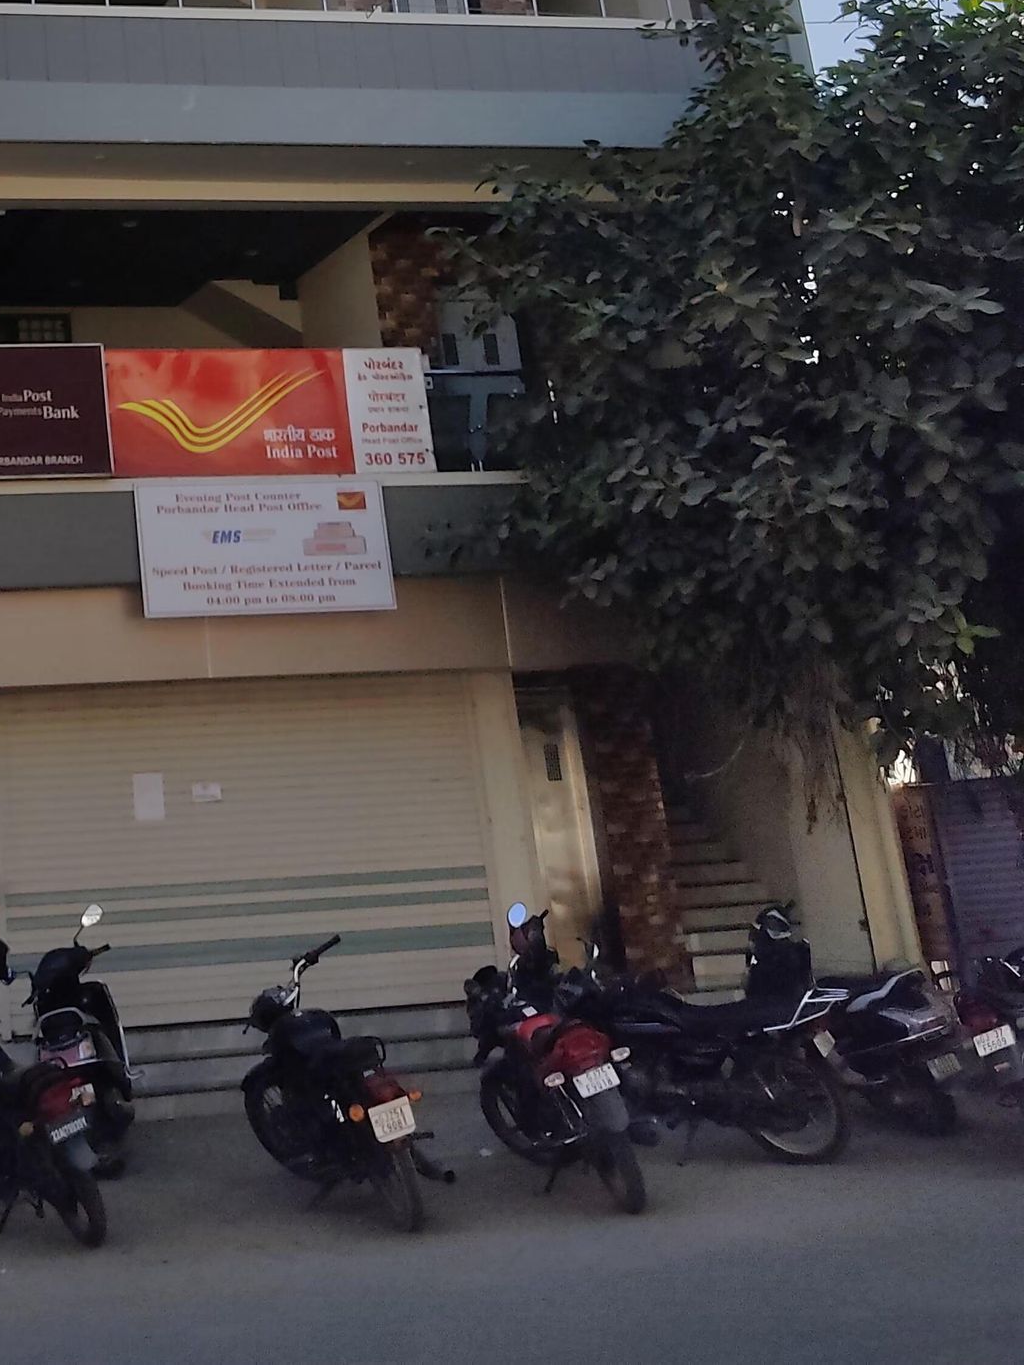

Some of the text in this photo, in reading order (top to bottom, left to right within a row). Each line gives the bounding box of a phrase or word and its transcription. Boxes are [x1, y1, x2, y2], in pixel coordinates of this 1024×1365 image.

[364, 357, 404, 370] પોરબંદર
[2, 390, 52, 403] India Post
[43, 405, 79, 419] Bank
[263, 424, 336, 443] भारतीय डाक
[362, 422, 418, 432] Porbandar
[400, 436, 423, 444] Office
[266, 445, 337, 459] India Post
[45, 455, 83, 466] BRANCH
[365, 452, 426, 466] 360 575
[175, 492, 301, 504] Evening Post Counter
[156, 502, 322, 514] Porbandar Head Post Office
[212, 530, 242, 544] EMS
[152, 566, 188, 578] Speed
[192, 566, 217, 576] Post
[230, 563, 293, 575] Registered
[297, 562, 333, 572] Letter
[344, 560, 381, 571] Parcel
[183, 577, 357, 591] Booking Time Extended from
[244, 597, 262, 606] pm
[266, 595, 278, 604] to
[318, 594, 336, 604] pm
